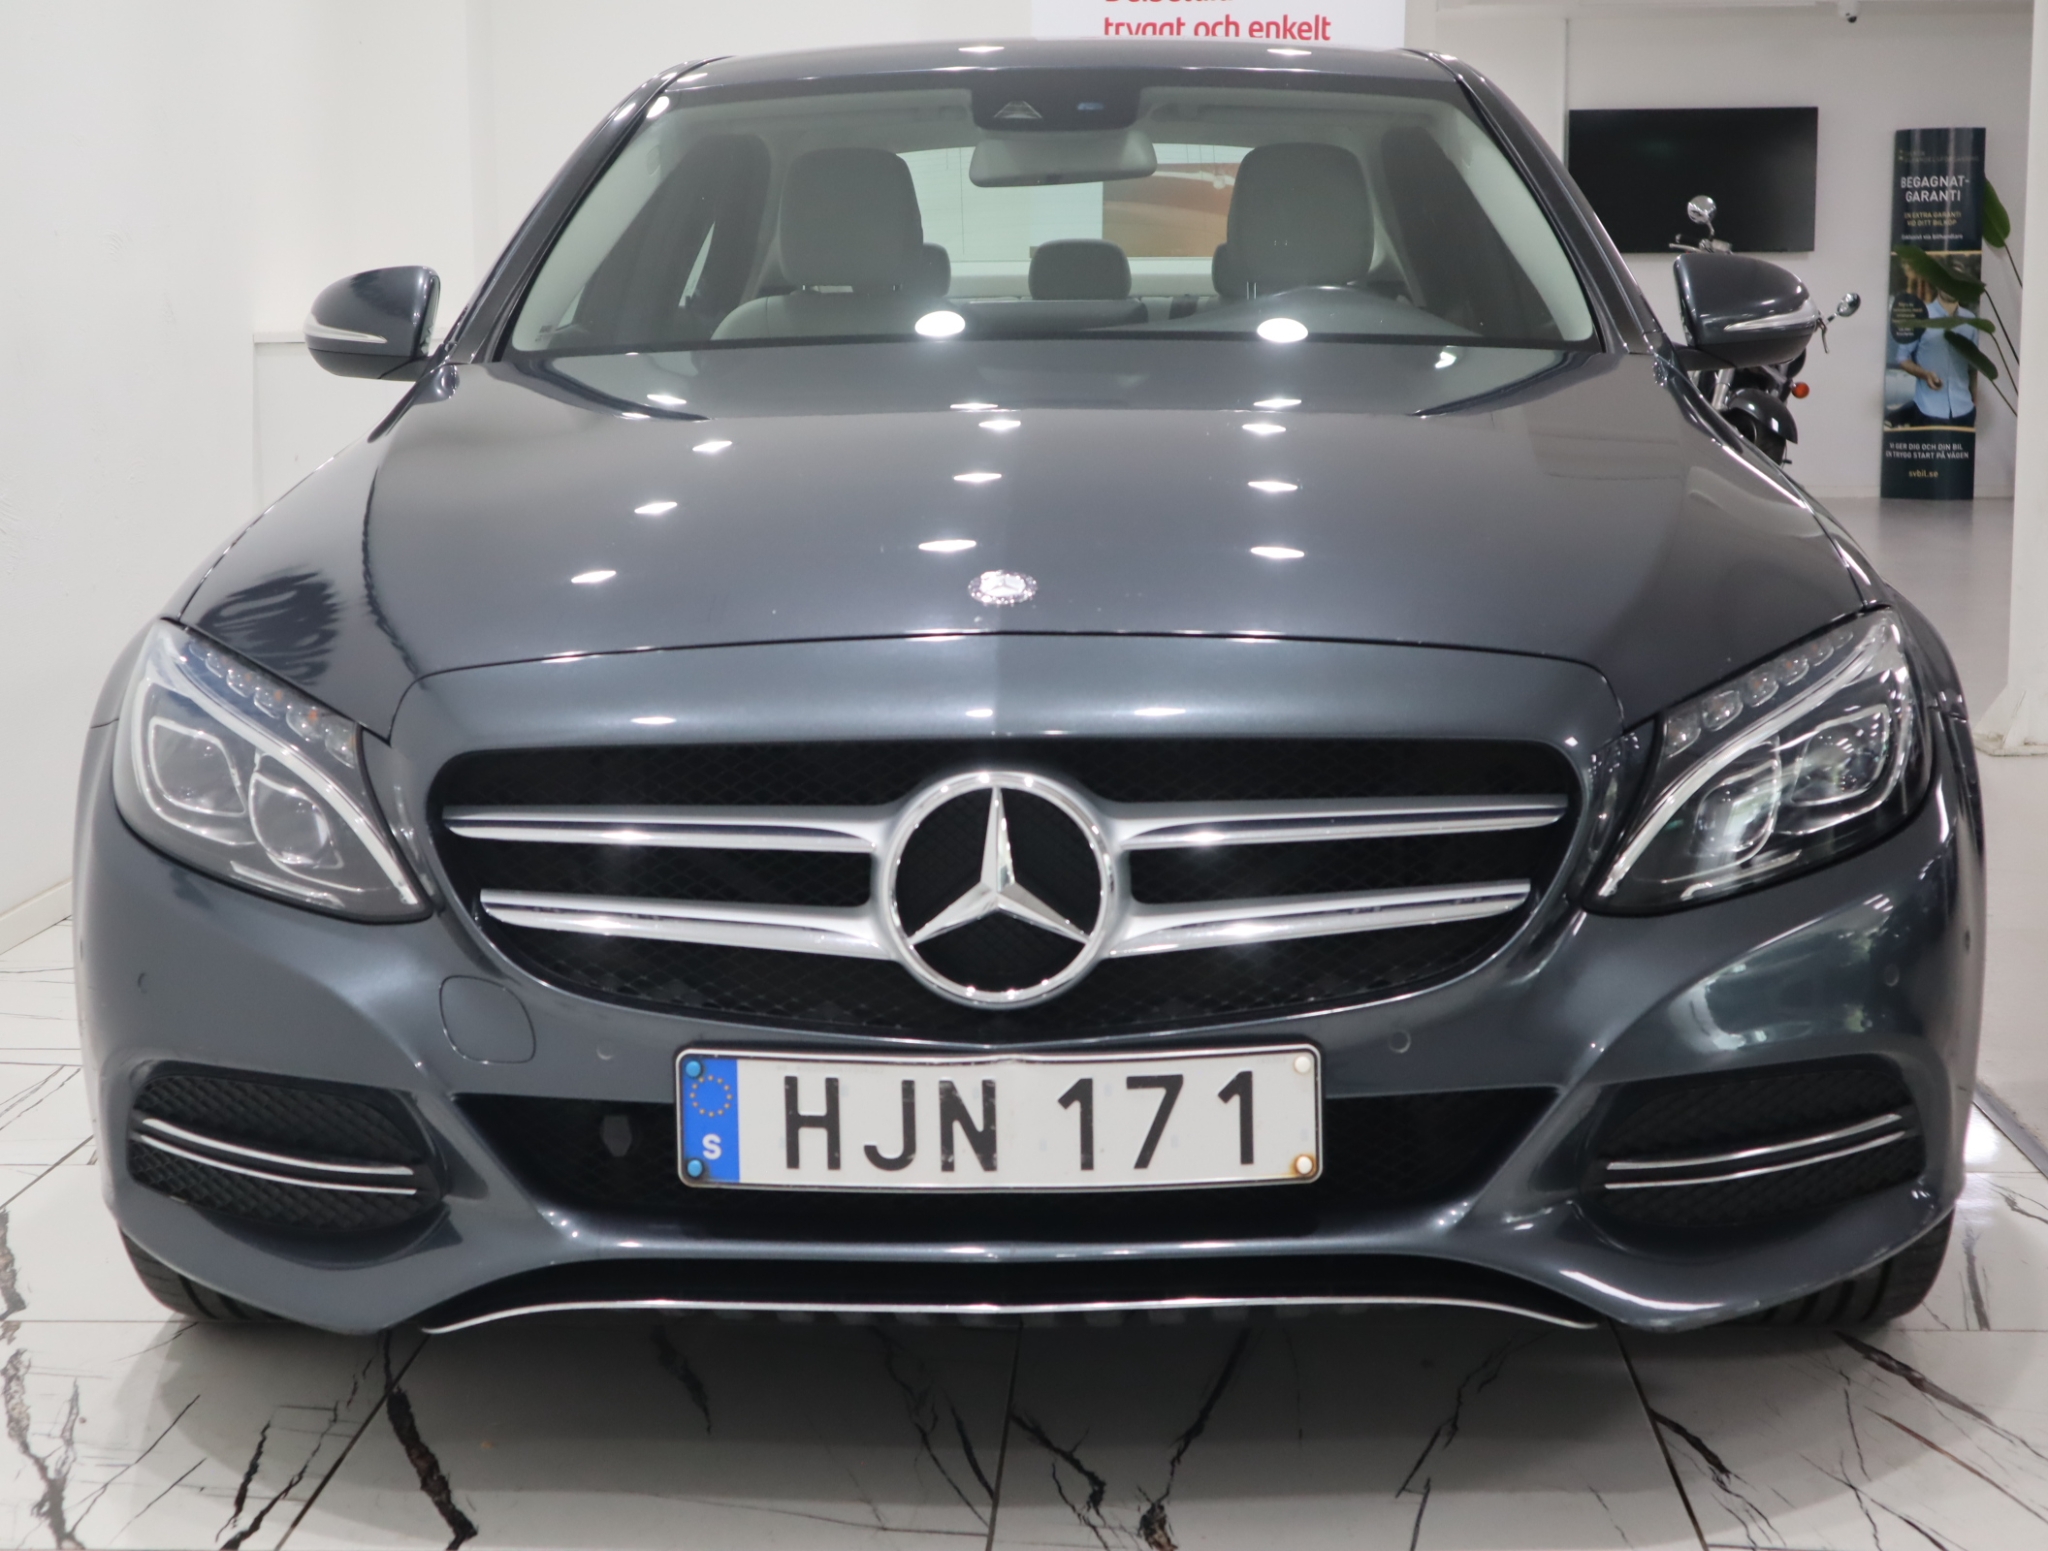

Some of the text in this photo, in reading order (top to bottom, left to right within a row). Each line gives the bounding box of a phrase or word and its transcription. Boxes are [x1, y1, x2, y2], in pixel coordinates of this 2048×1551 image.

[1193, 13, 1241, 37] och
[1248, 14, 1332, 40] enkelt
[1900, 175, 1970, 188] BEGAGNAT-
[1905, 189, 1961, 203] GARANTI
[1912, 451, 1934, 459] START
[1936, 450, 1946, 459] PÅ
[1946, 450, 1969, 459] VÄGEN
[1908, 469, 1939, 478] svbil.se
[782, 1070, 1255, 1173] HJN 171
[701, 1134, 722, 1161] S
